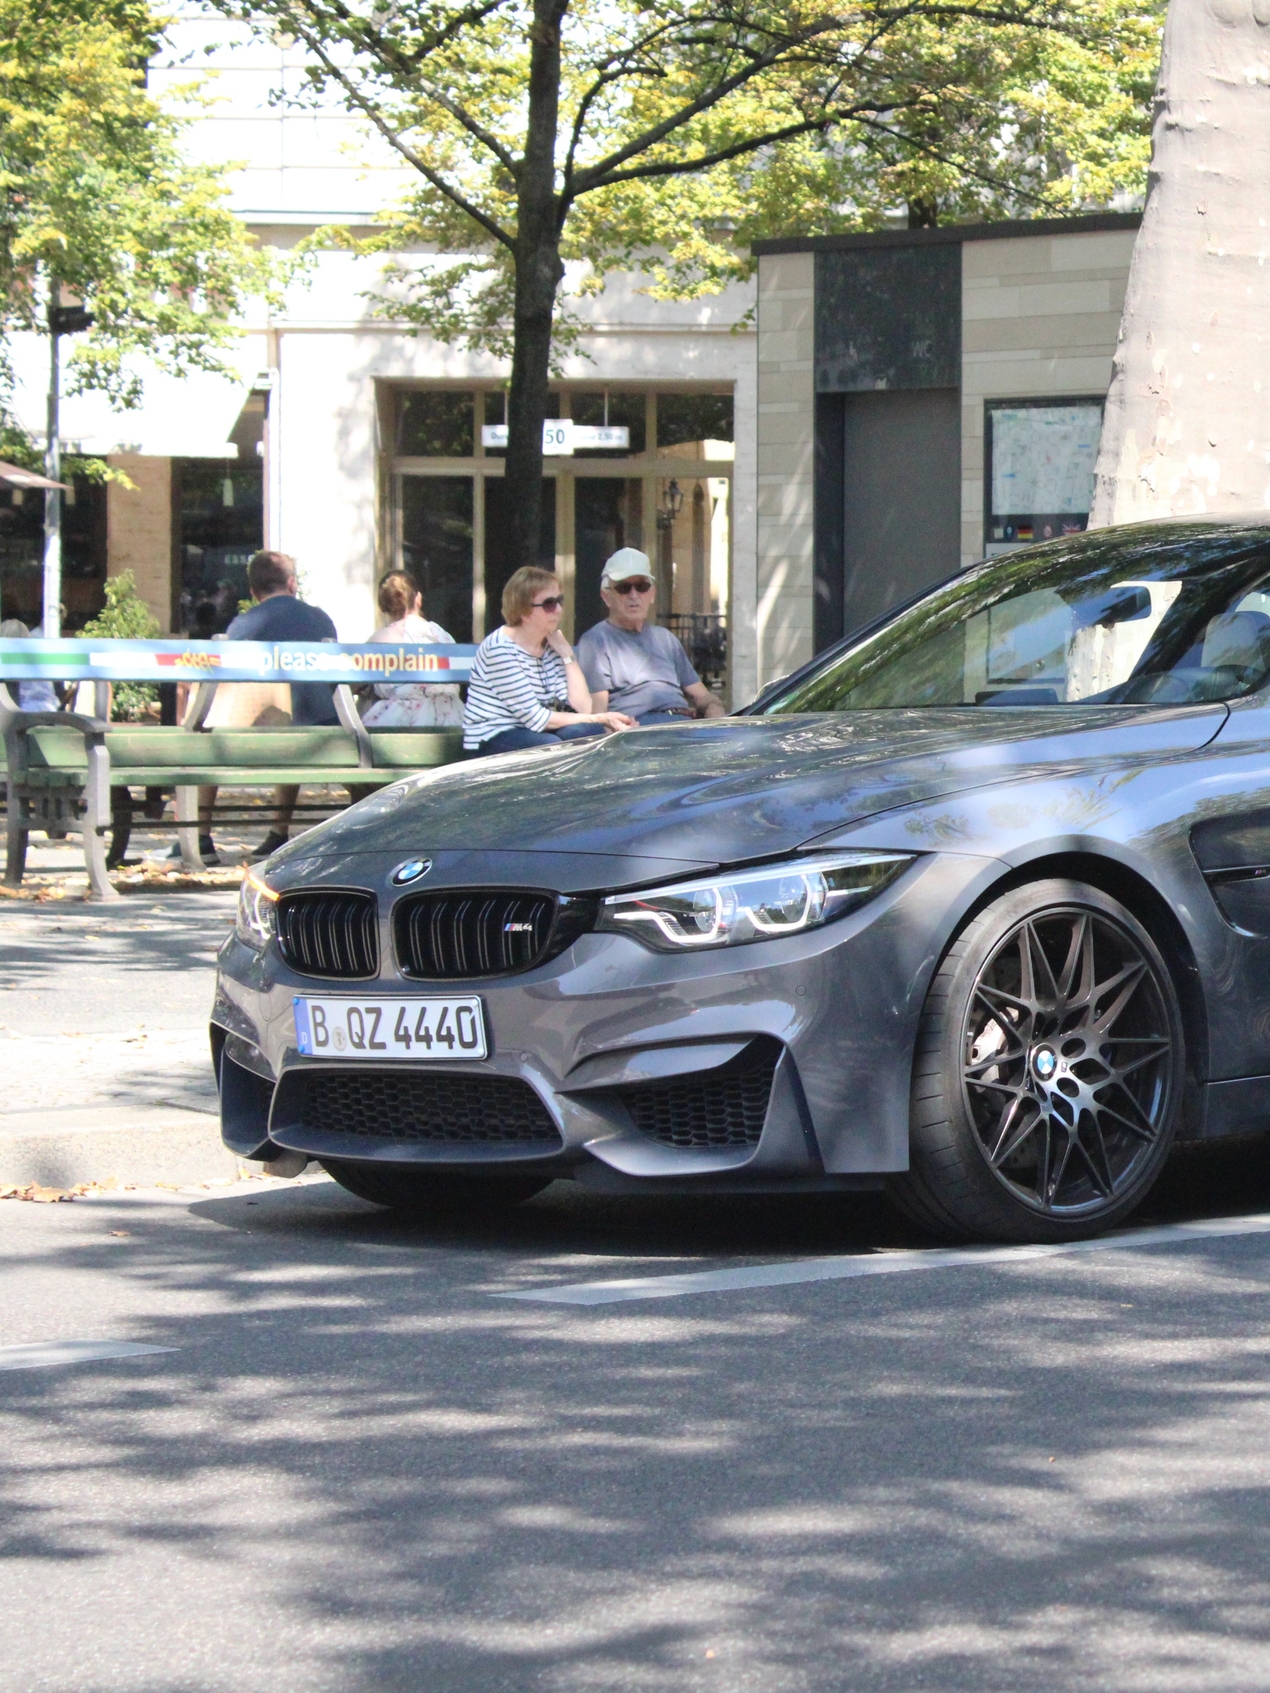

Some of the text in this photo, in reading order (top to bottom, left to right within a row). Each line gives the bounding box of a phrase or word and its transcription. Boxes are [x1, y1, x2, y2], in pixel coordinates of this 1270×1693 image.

[911, 340, 932, 357] WC
[545, 429, 565, 444] 50
[311, 1005, 478, 1050] B QZ 4440
[301, 1031, 308, 1044] D
